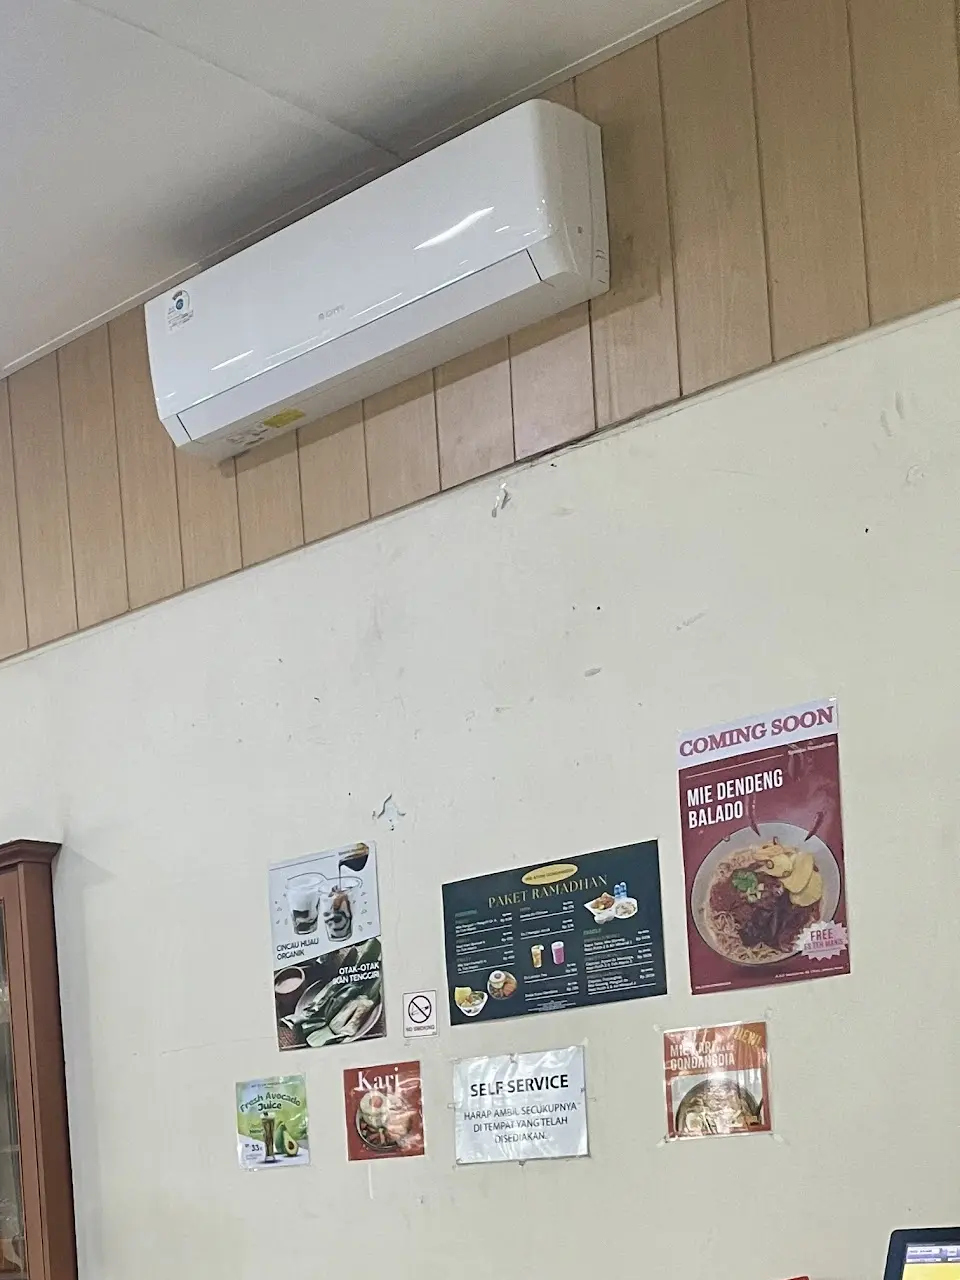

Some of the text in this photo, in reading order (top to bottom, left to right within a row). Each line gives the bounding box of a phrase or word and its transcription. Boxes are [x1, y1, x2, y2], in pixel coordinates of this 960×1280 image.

[679, 722, 768, 757] COMING
[771, 705, 834, 736] SOON
[686, 768, 784, 808] MIE DENDENG
[688, 801, 744, 829] BALADO
[488, 874, 608, 909] PAKET RAMADHAN
[810, 928, 834, 941] FREE
[276, 940, 299, 952] CINCAU
[276, 949, 305, 961] ORGANIK
[338, 961, 380, 975] OTAK-OTAK
[333, 970, 380, 985] IKAN TENGGIRI
[670, 1052, 736, 1071] GONDANGDIA
[356, 1066, 400, 1091] Kari
[470, 1074, 569, 1097] SELF SERVICE
[239, 1091, 301, 1113] Fresh Avocado
[257, 1100, 282, 1111] Juice
[464, 1102, 577, 1120] HARAP AMBIL SECUKUPNYA
[473, 1116, 568, 1133] DI TEMPAT YANG TELAH
